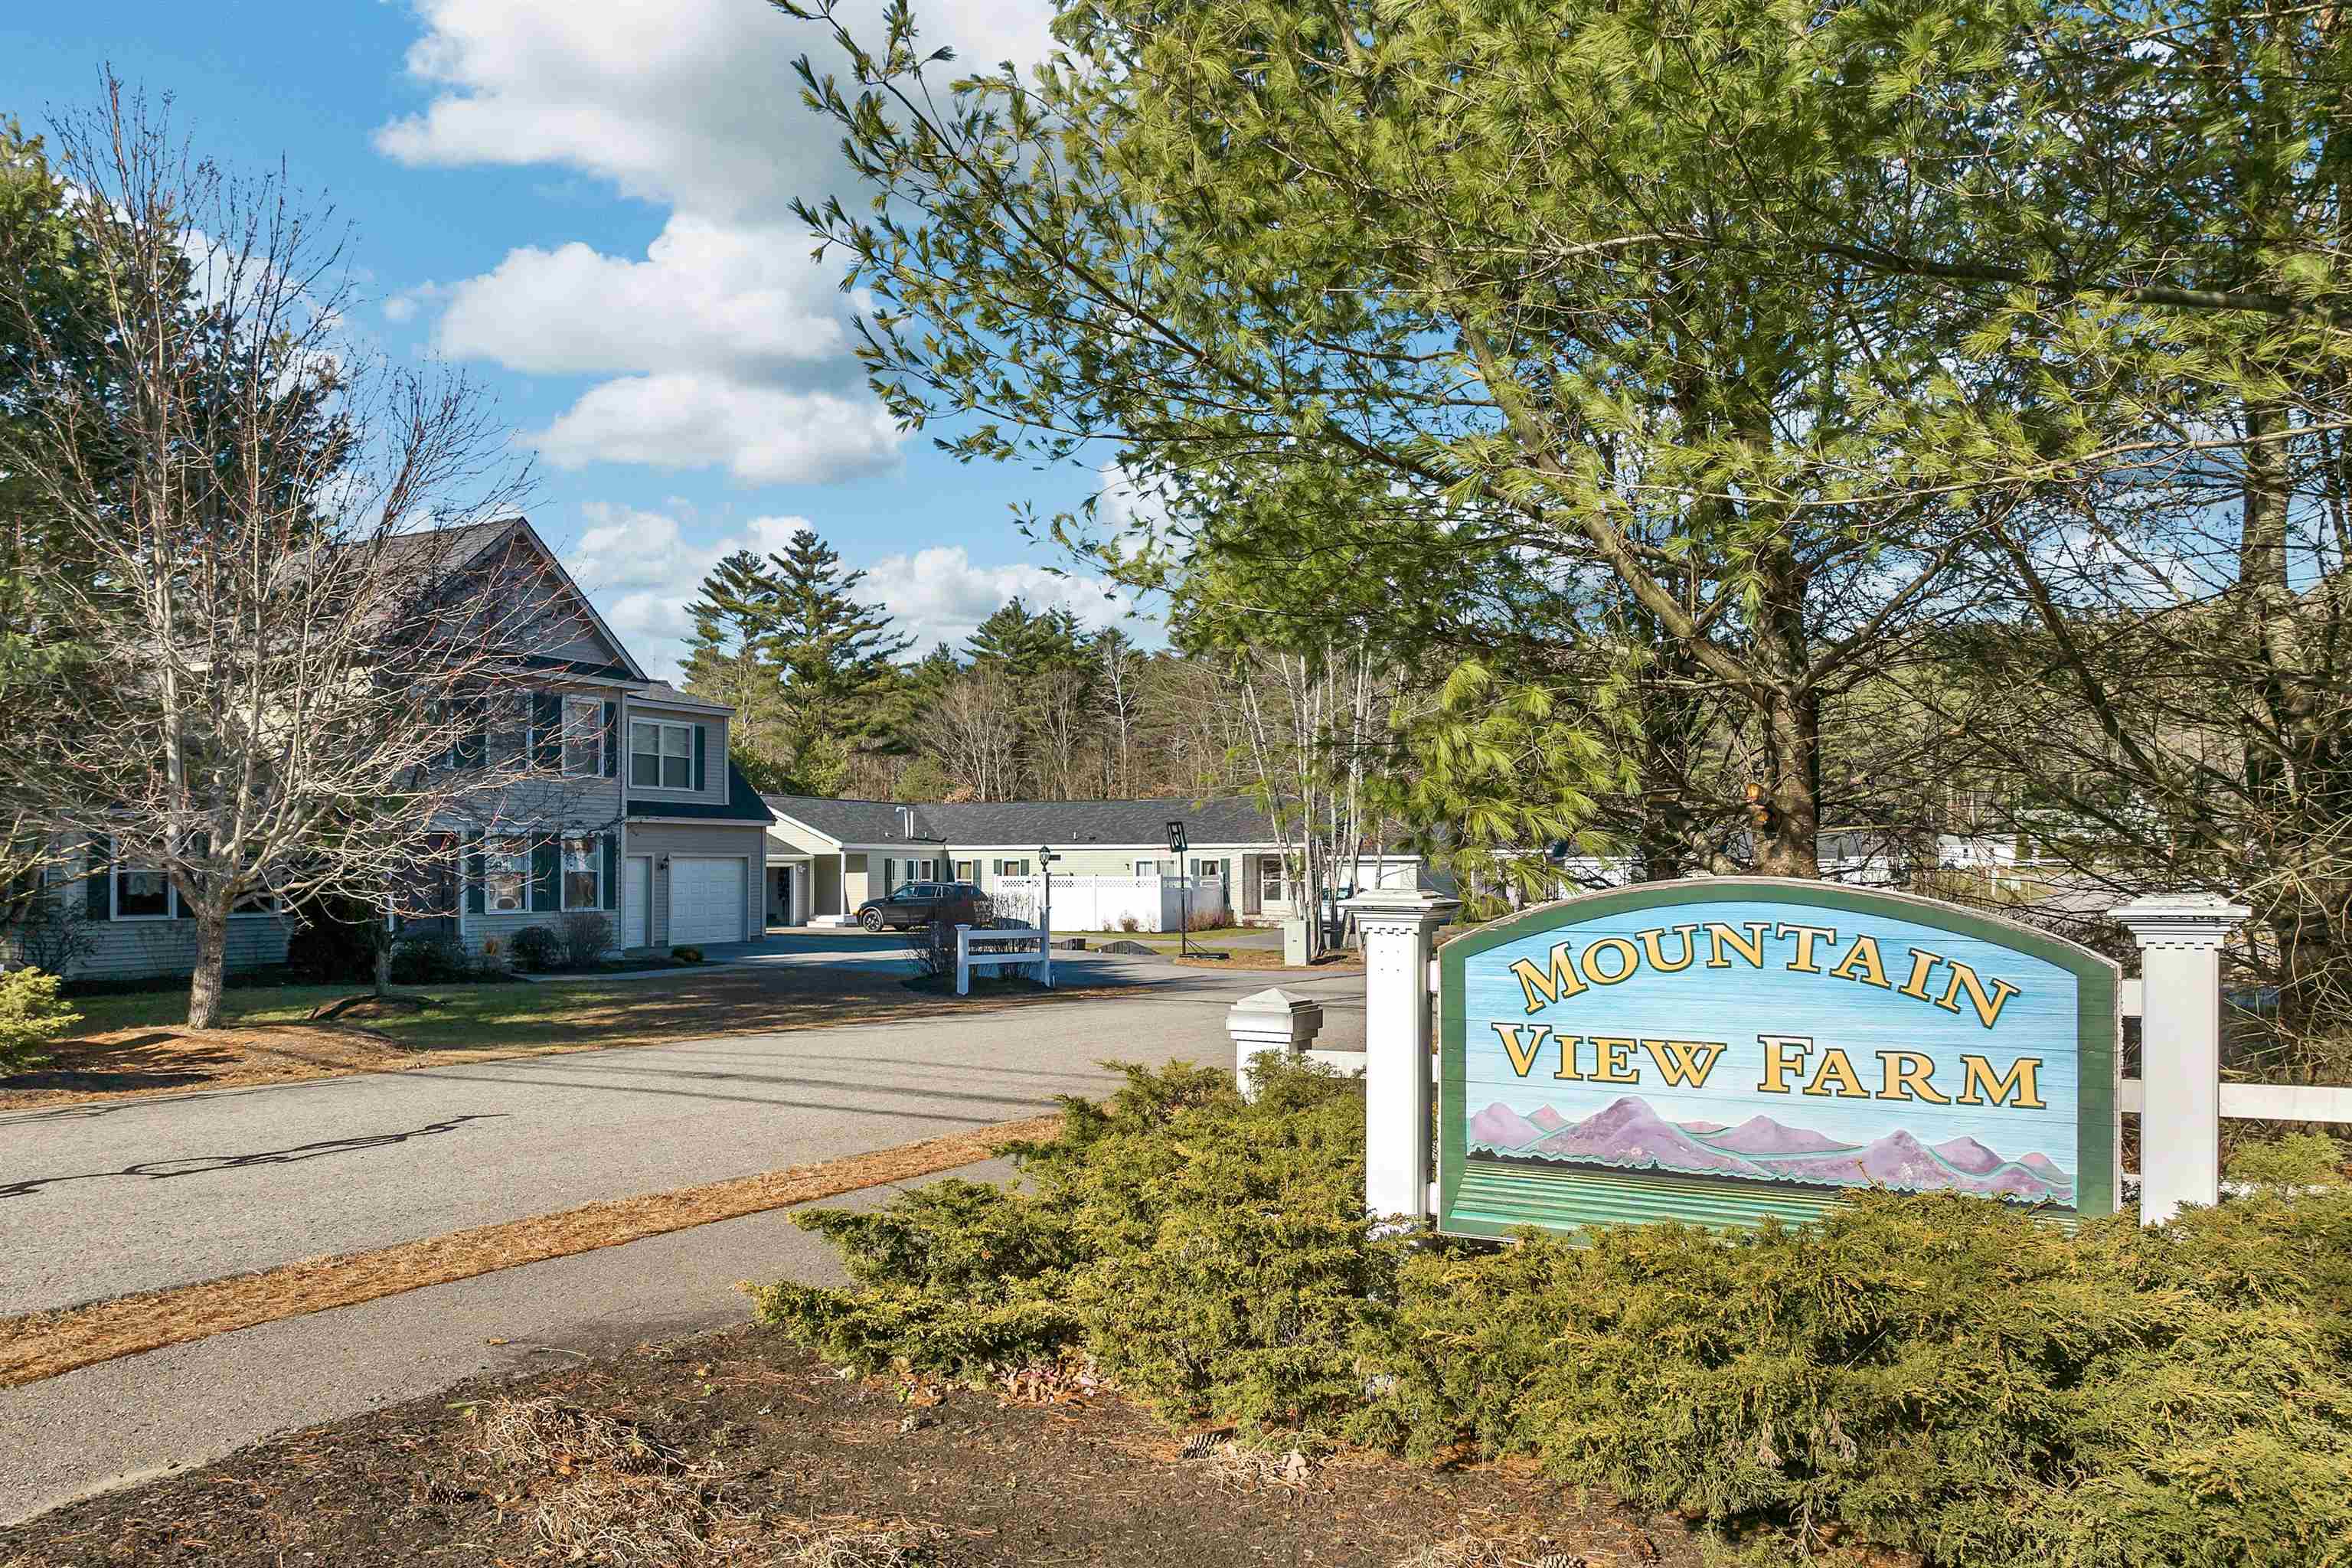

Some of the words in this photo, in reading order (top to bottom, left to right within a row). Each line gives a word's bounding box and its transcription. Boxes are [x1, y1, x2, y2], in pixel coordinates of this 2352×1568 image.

[1509, 922, 2020, 1029] MOUNTAIN
[1491, 1023, 1727, 1088] VIEW
[1757, 1034, 2047, 1109] FARM
